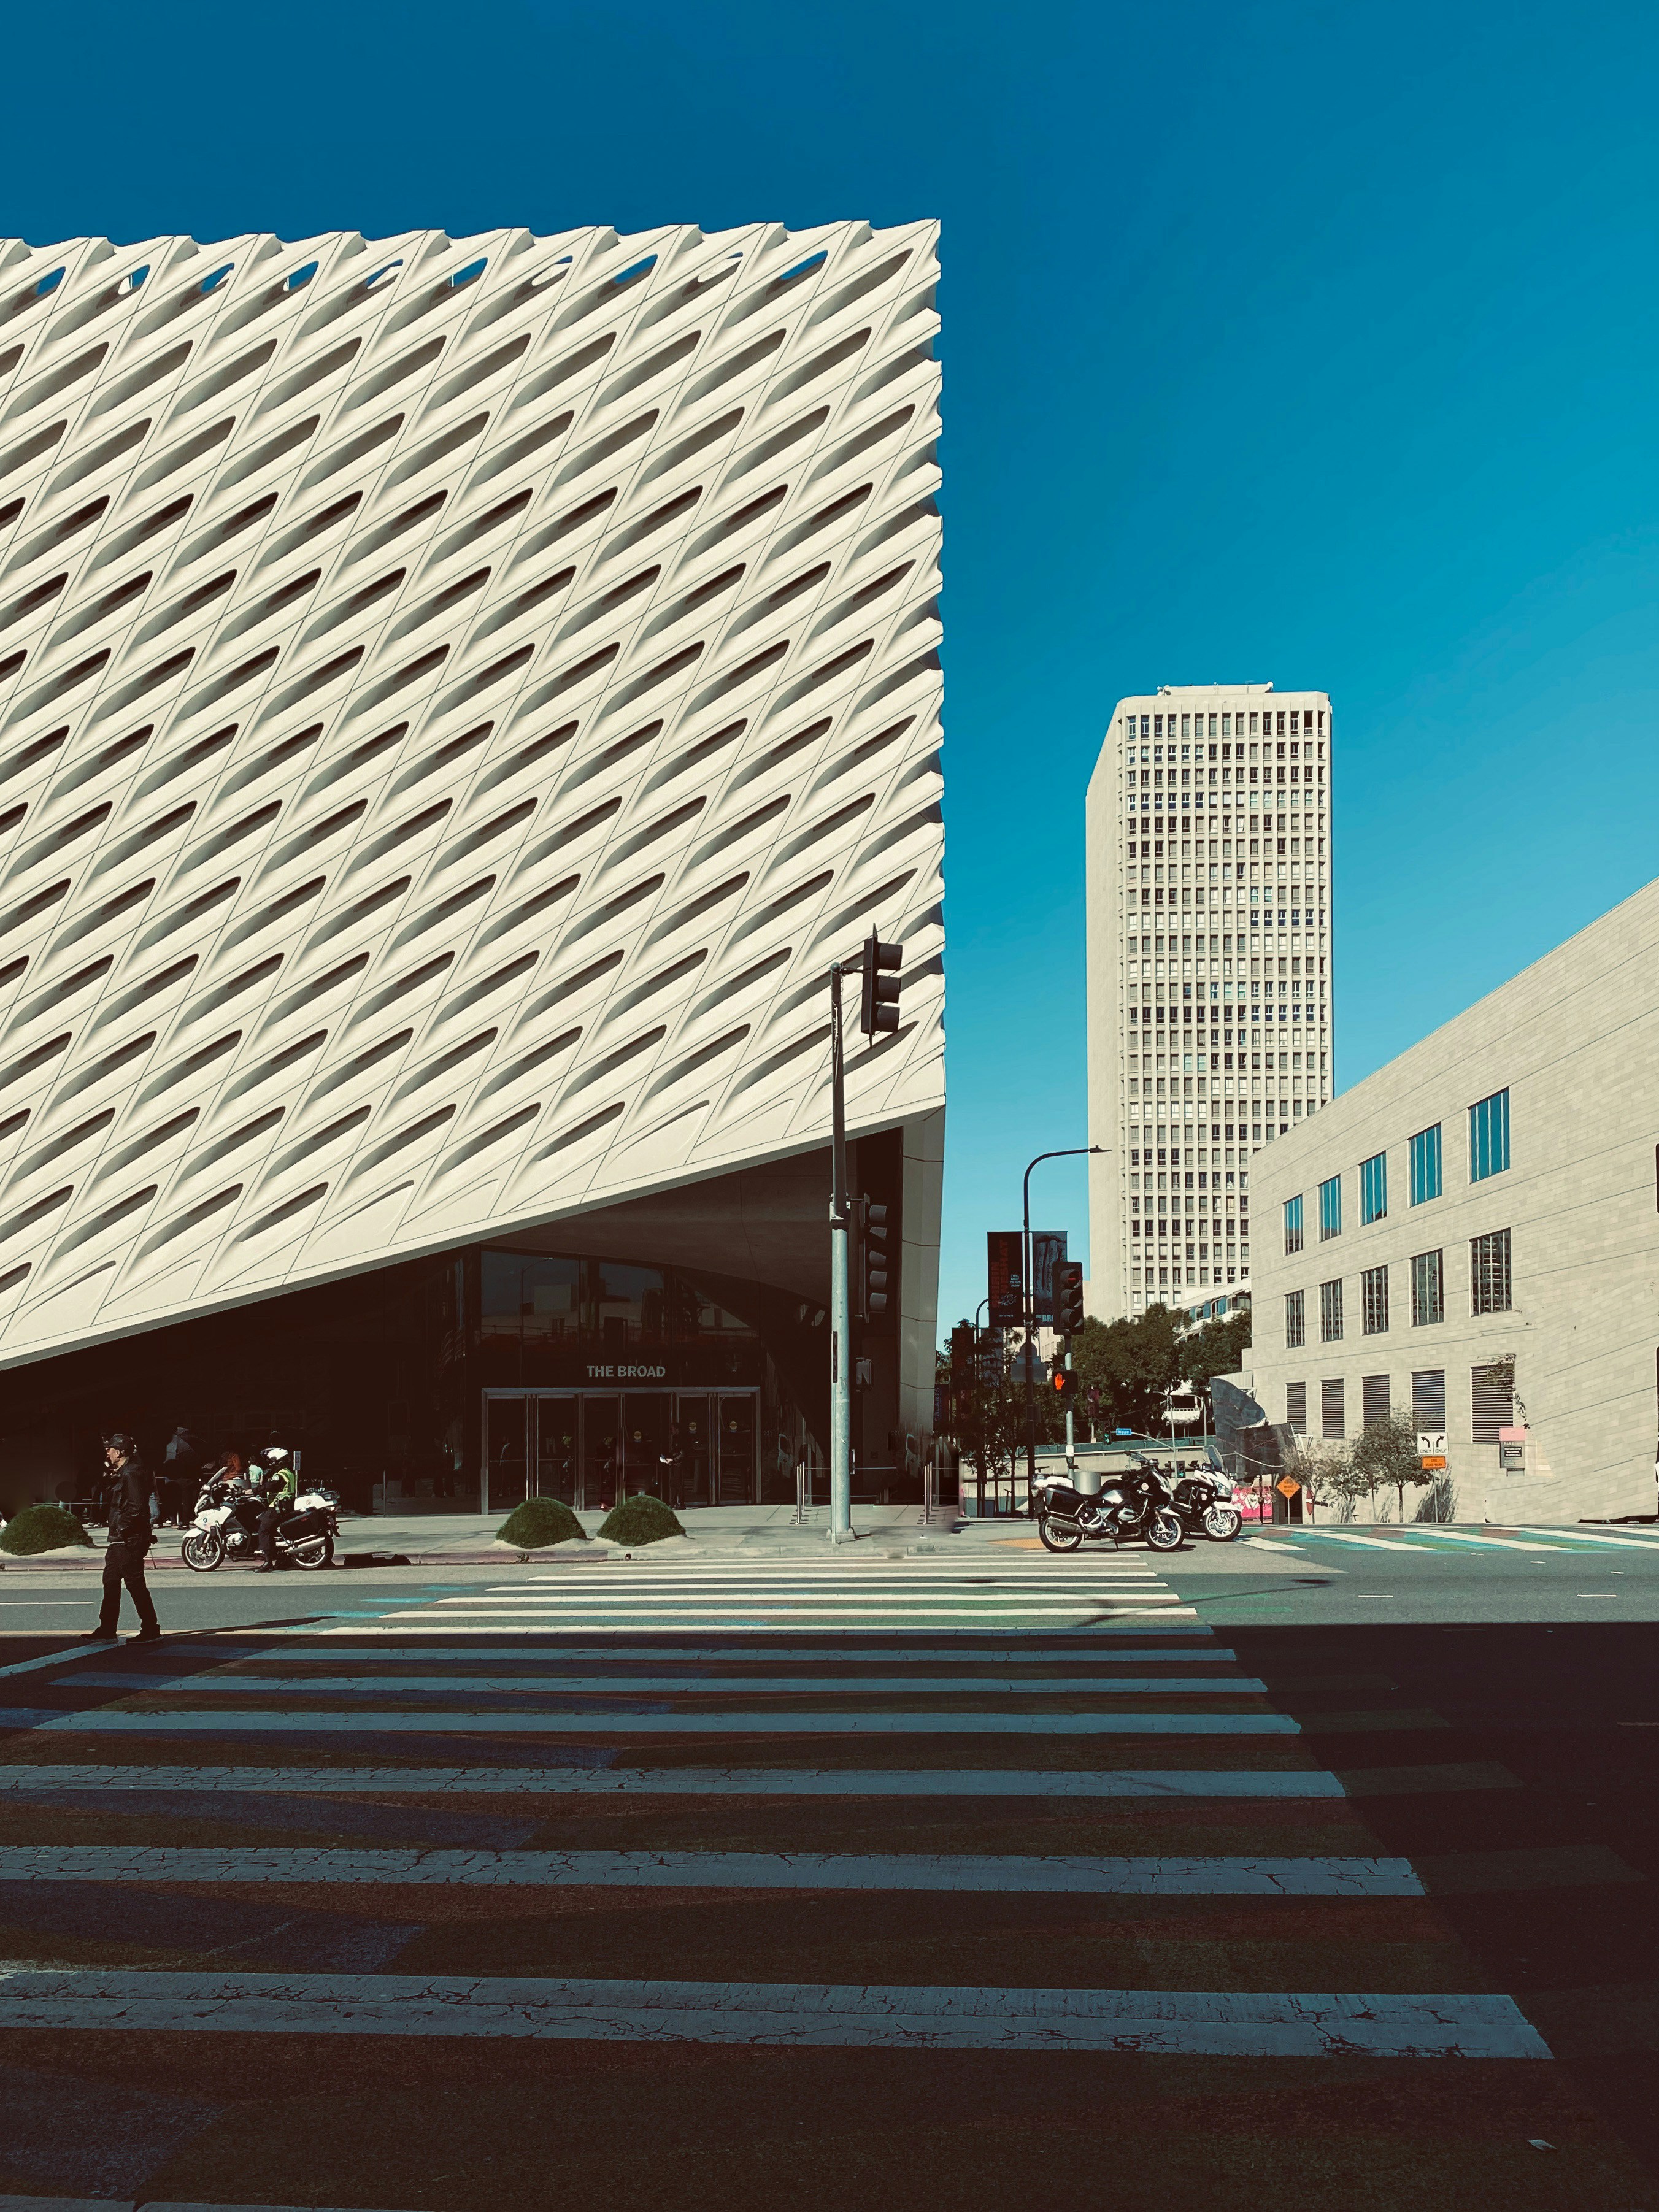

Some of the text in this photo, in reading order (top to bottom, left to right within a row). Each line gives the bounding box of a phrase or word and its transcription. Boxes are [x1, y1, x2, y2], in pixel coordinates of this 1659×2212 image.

[991, 1262, 999, 1308] SHIRIN
[1000, 1239, 1008, 1294] NESHAT
[586, 1366, 666, 1377] THE BROAD
